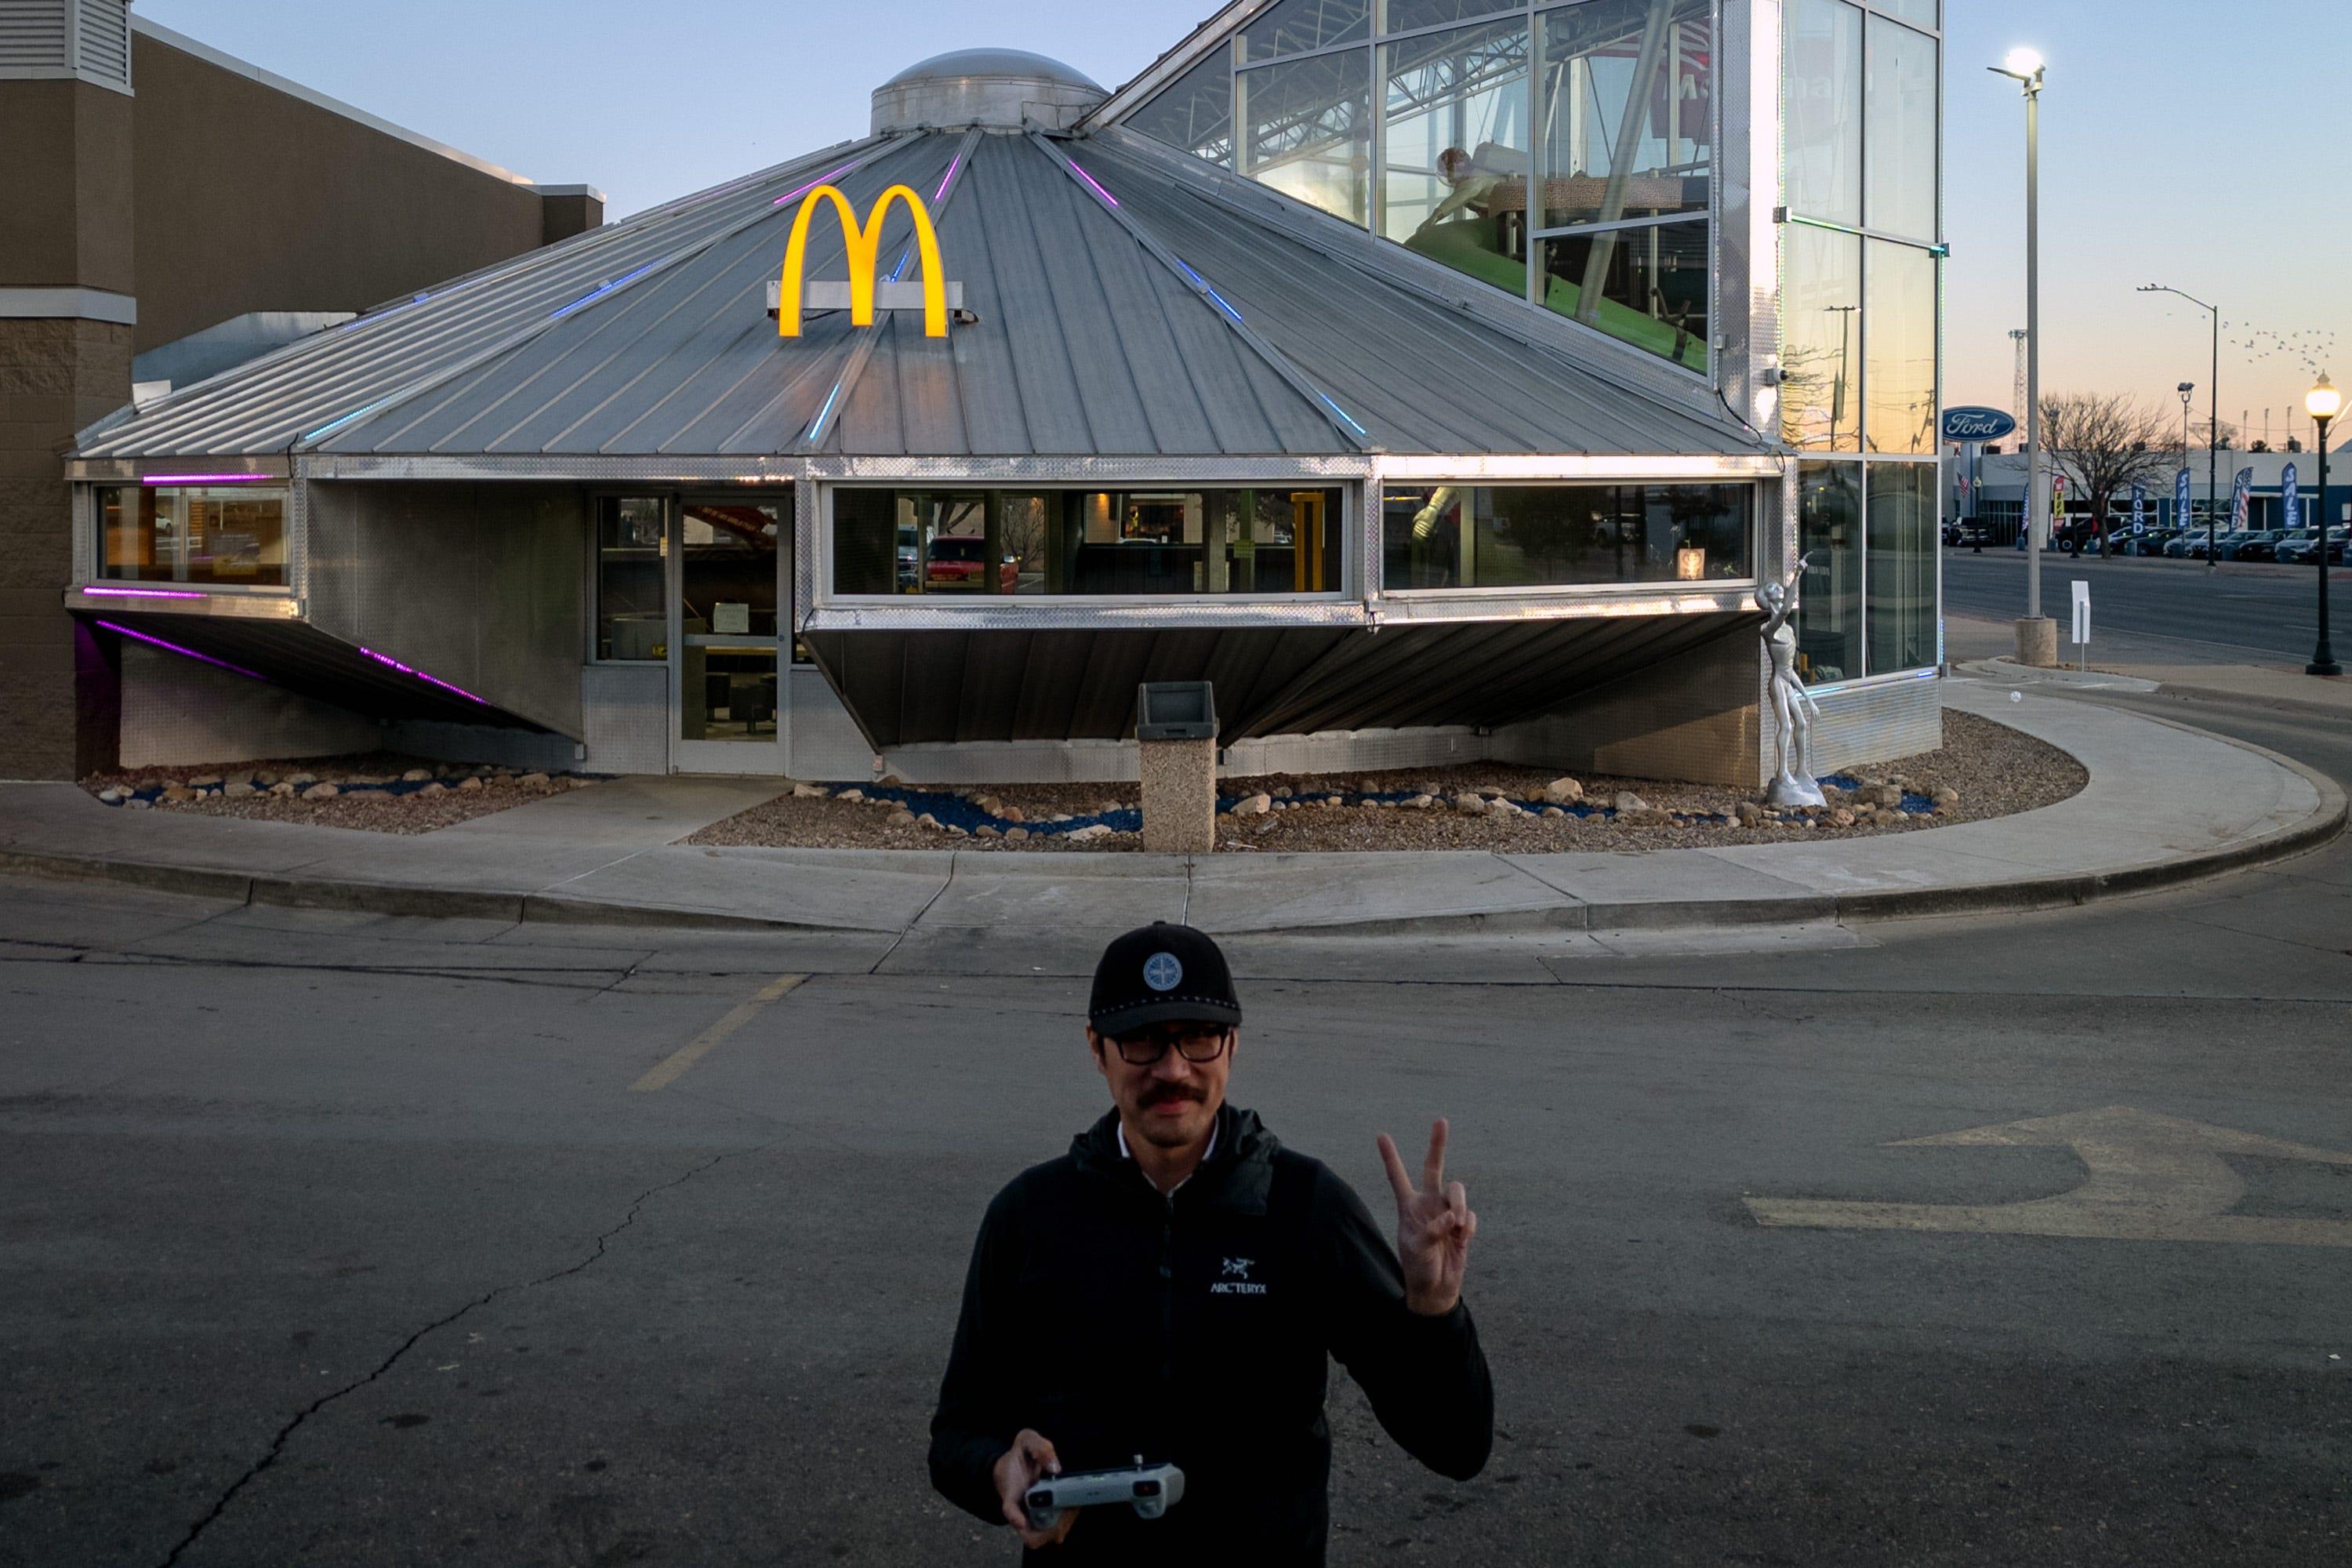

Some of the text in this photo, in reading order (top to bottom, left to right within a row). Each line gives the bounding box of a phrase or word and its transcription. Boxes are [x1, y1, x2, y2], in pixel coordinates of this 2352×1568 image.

[1946, 413, 1999, 434] Ford
[2180, 474, 2189, 526] SALE
[2230, 474, 2243, 528] SALE
[2284, 468, 2298, 525] SALE
